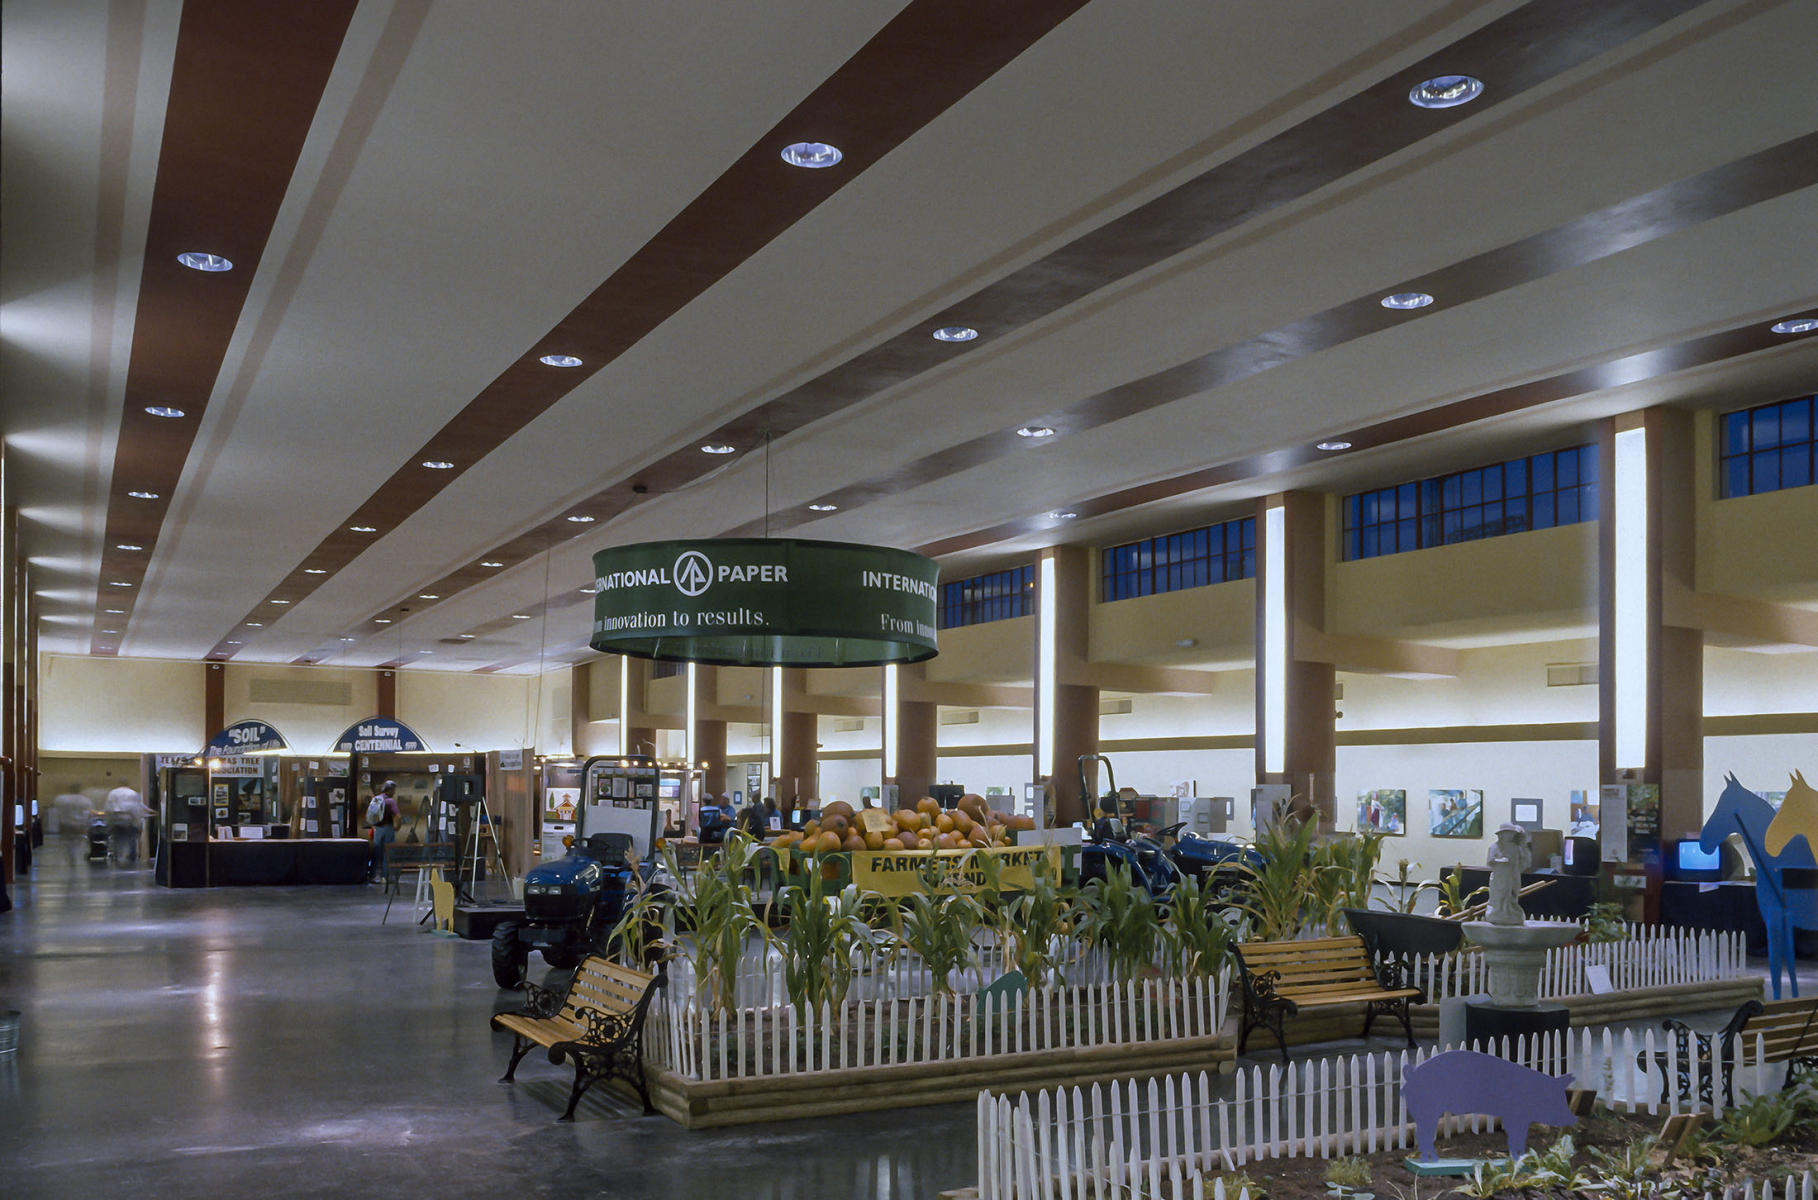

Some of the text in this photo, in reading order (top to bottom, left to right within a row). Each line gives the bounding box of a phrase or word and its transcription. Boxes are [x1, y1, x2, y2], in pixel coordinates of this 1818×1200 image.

[718, 565, 789, 582] PAPER
[604, 611, 666, 631] innovation
[673, 610, 690, 627] to
[697, 607, 769, 626] results.
[881, 613, 914, 635] From
[358, 725, 399, 738] Soil Survey
[354, 738, 402, 751] CENTENNIAL
[241, 757, 260, 765] TREE
